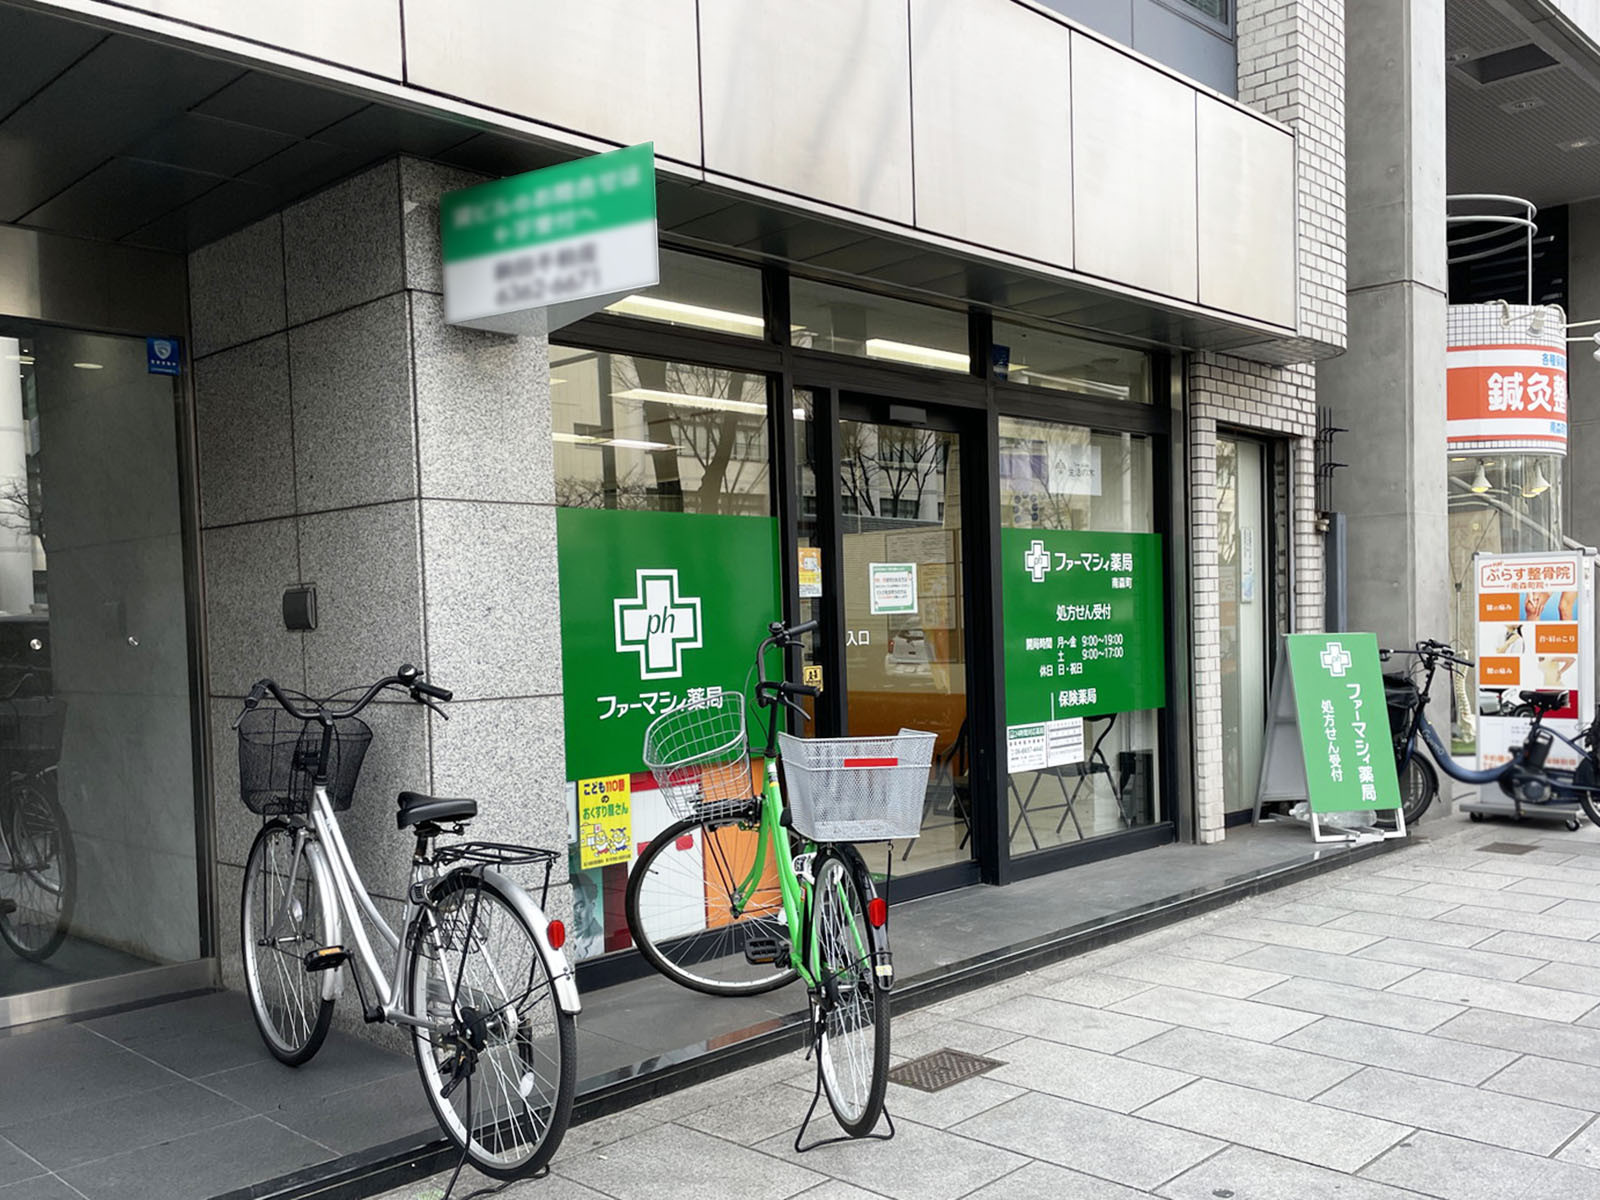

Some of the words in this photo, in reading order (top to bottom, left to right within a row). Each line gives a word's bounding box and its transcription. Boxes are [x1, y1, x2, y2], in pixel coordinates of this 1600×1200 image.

[1054, 552, 1133, 572] ファーマシィ薬局
[1056, 603, 1111, 621] 処方せん受付
[648, 605, 675, 641] ph
[846, 631, 870, 646] 入口
[1057, 650, 1065, 662] 土
[1039, 664, 1053, 677] 休日
[597, 686, 723, 720] ファーマシィ薬局
[1058, 688, 1097, 707] 保険薬局
[1321, 700, 1343, 782] 処方せん受付
[1346, 683, 1377, 801] ファーマシィ薬局
[601, 795, 610, 803] の
